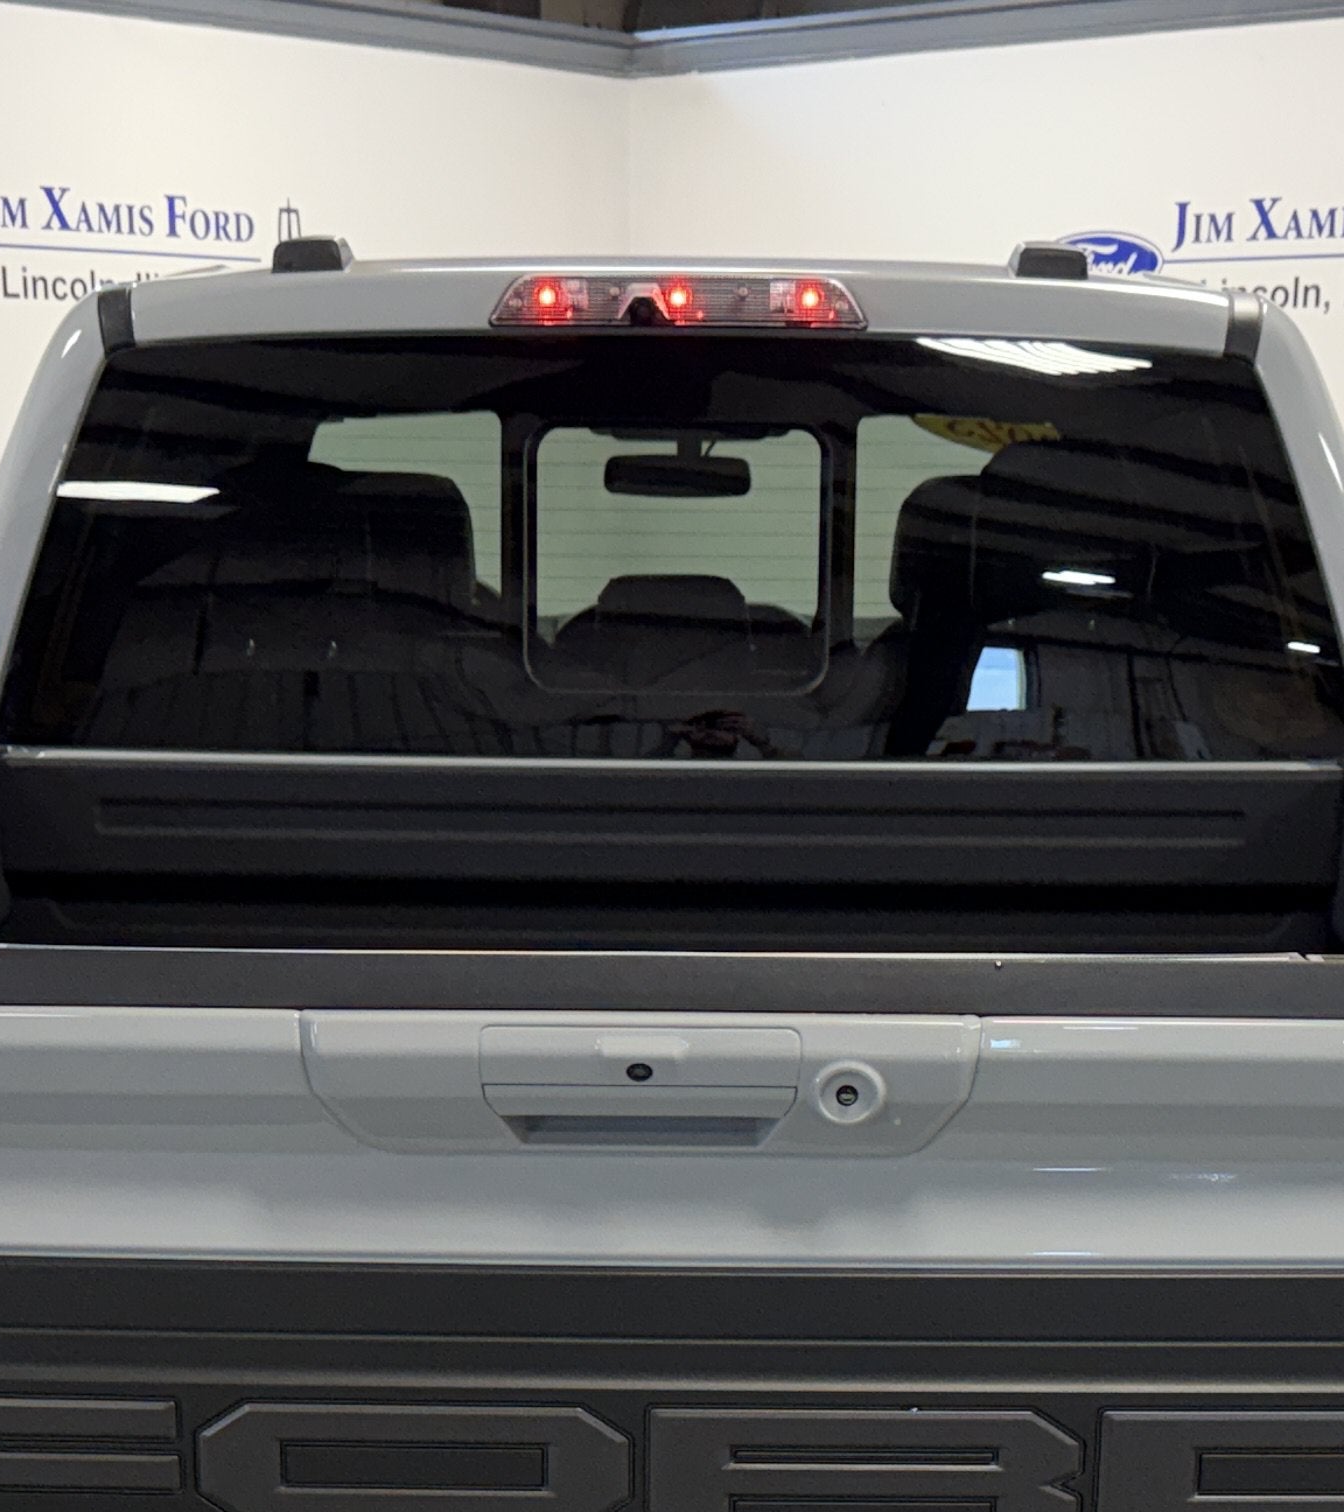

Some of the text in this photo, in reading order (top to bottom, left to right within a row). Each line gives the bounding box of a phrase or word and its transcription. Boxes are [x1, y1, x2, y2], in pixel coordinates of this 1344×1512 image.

[40, 186, 154, 236] XAMIS
[164, 194, 255, 242] FORD
[1172, 201, 1235, 252] JIM
[1, 265, 114, 300] Lincol
